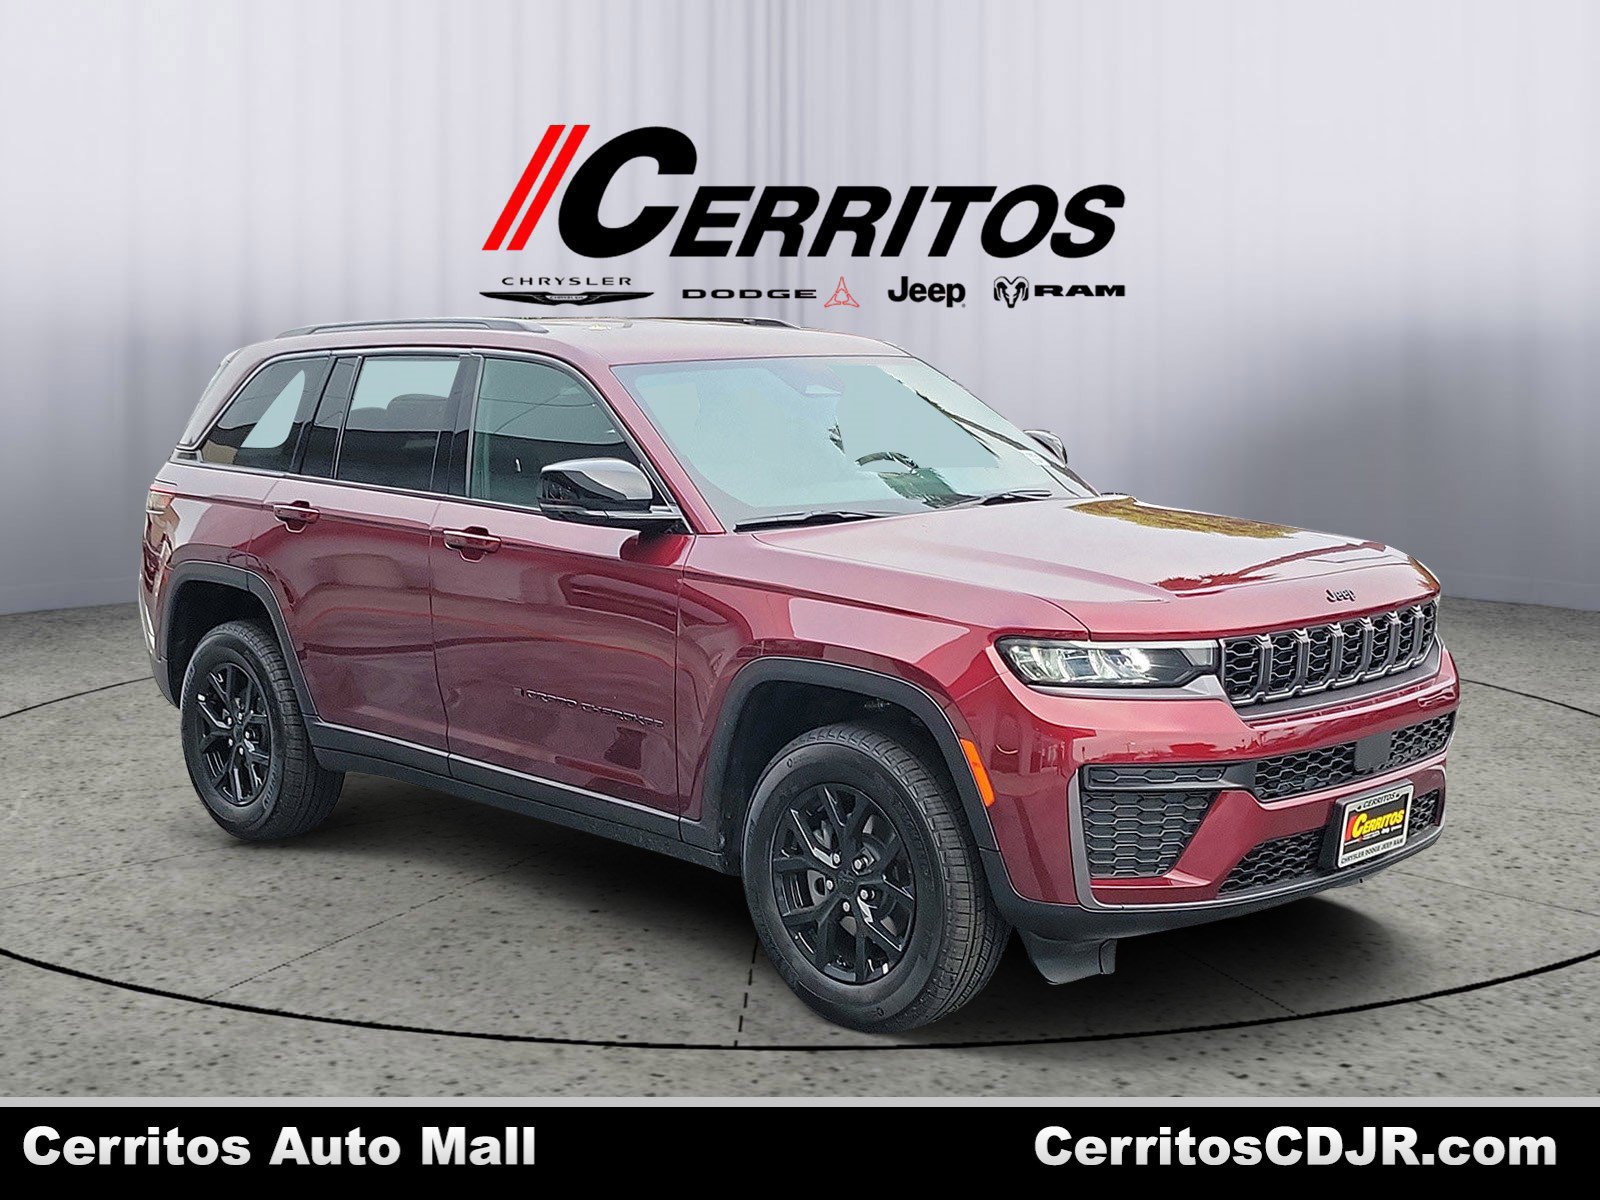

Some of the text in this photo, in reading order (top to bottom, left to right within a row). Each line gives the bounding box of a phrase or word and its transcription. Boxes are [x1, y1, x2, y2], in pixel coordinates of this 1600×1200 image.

[1325, 588, 1356, 603] Jeep
[1363, 792, 1395, 808] CERRITOS
[1351, 809, 1405, 839] CERRITOS
